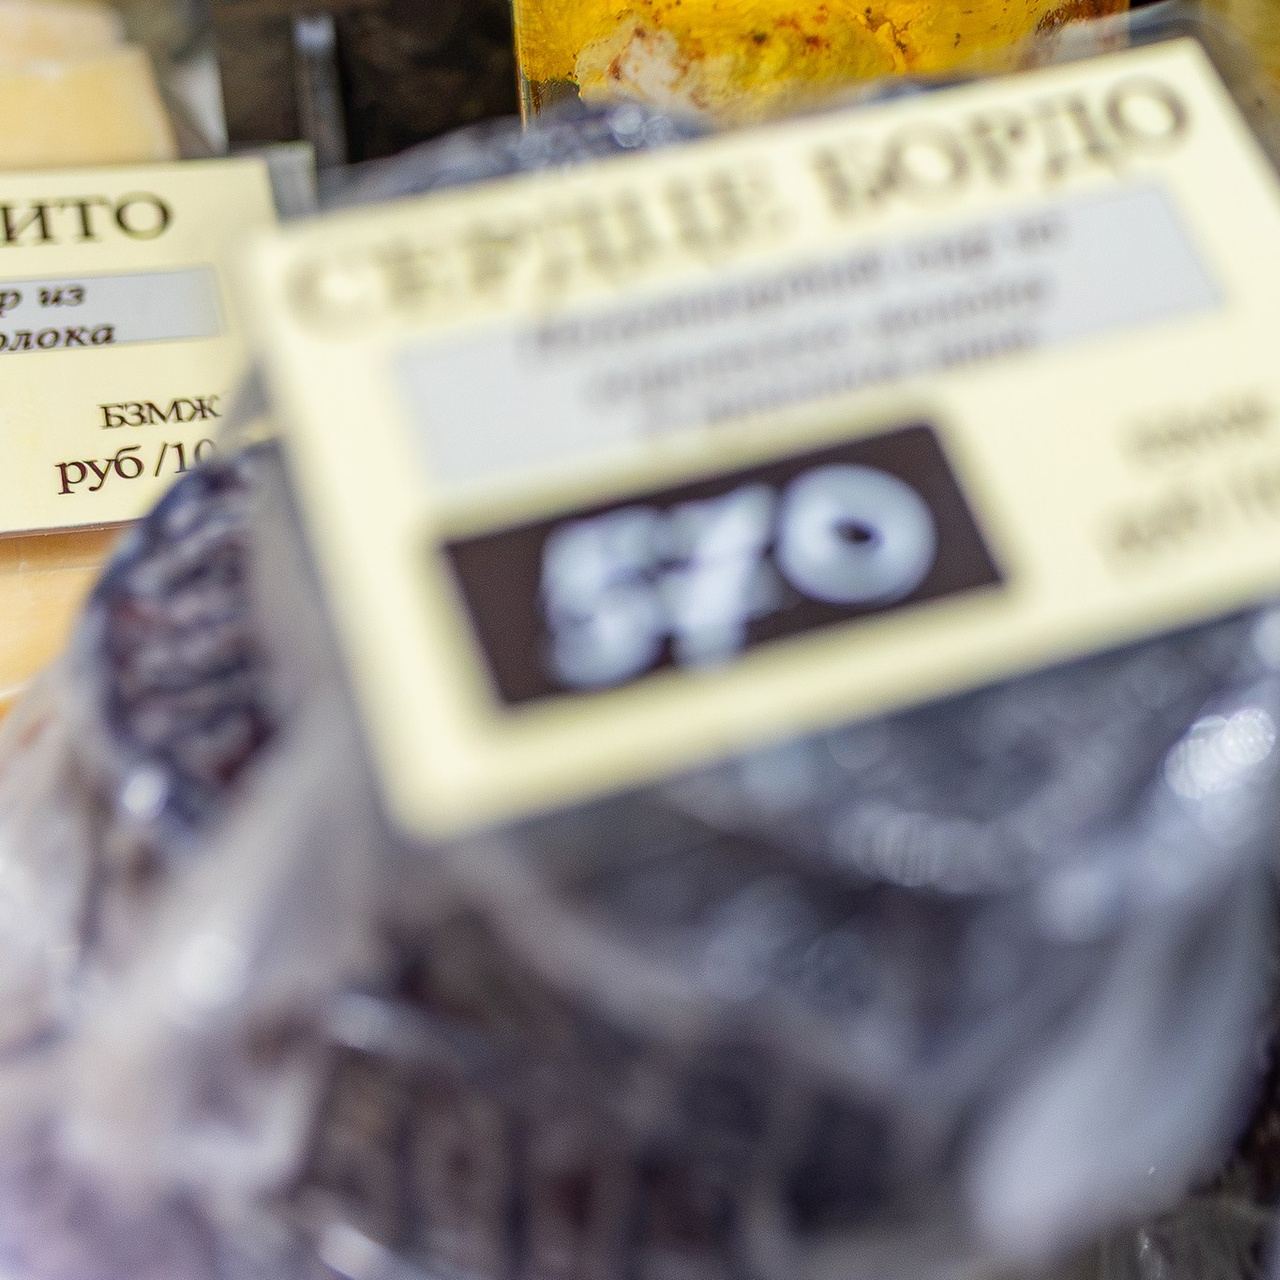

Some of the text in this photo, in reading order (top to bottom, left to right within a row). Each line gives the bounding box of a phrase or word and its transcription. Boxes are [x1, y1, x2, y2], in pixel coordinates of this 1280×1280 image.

[816, 75, 1188, 219] БОРДО
[38, 284, 86, 307] из
[98, 393, 222, 429] БЗМЖ
